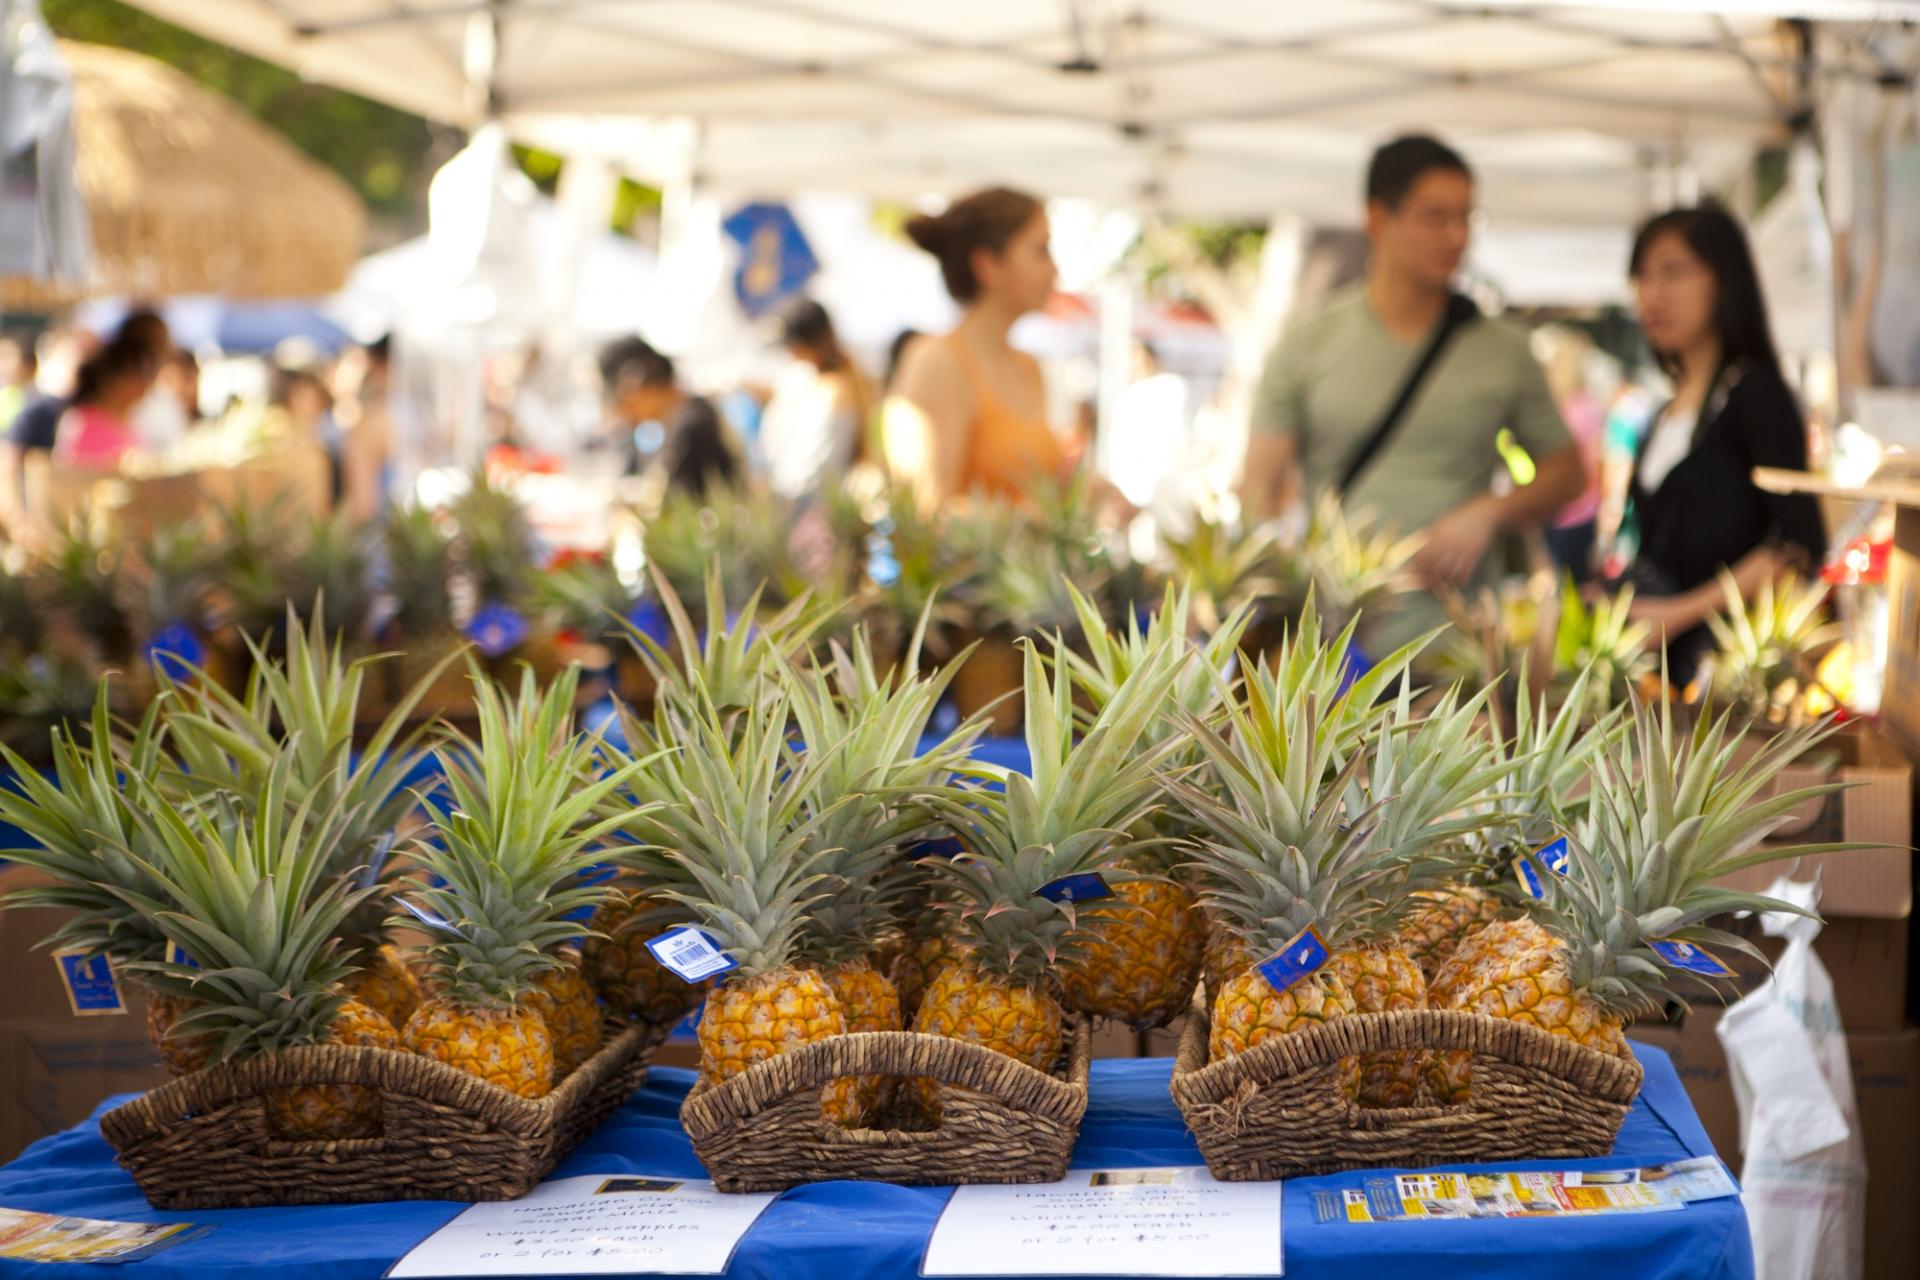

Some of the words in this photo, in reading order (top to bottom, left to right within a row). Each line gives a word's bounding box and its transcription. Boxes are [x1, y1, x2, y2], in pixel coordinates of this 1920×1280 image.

[512, 1198, 626, 1213] Hawaiian
[570, 1223, 700, 1233] Pineapples
[1021, 1236, 1042, 1245] or
[1056, 1236, 1073, 1244] 2
[1084, 1235, 1118, 1245] for
[541, 1248, 573, 1258] for
